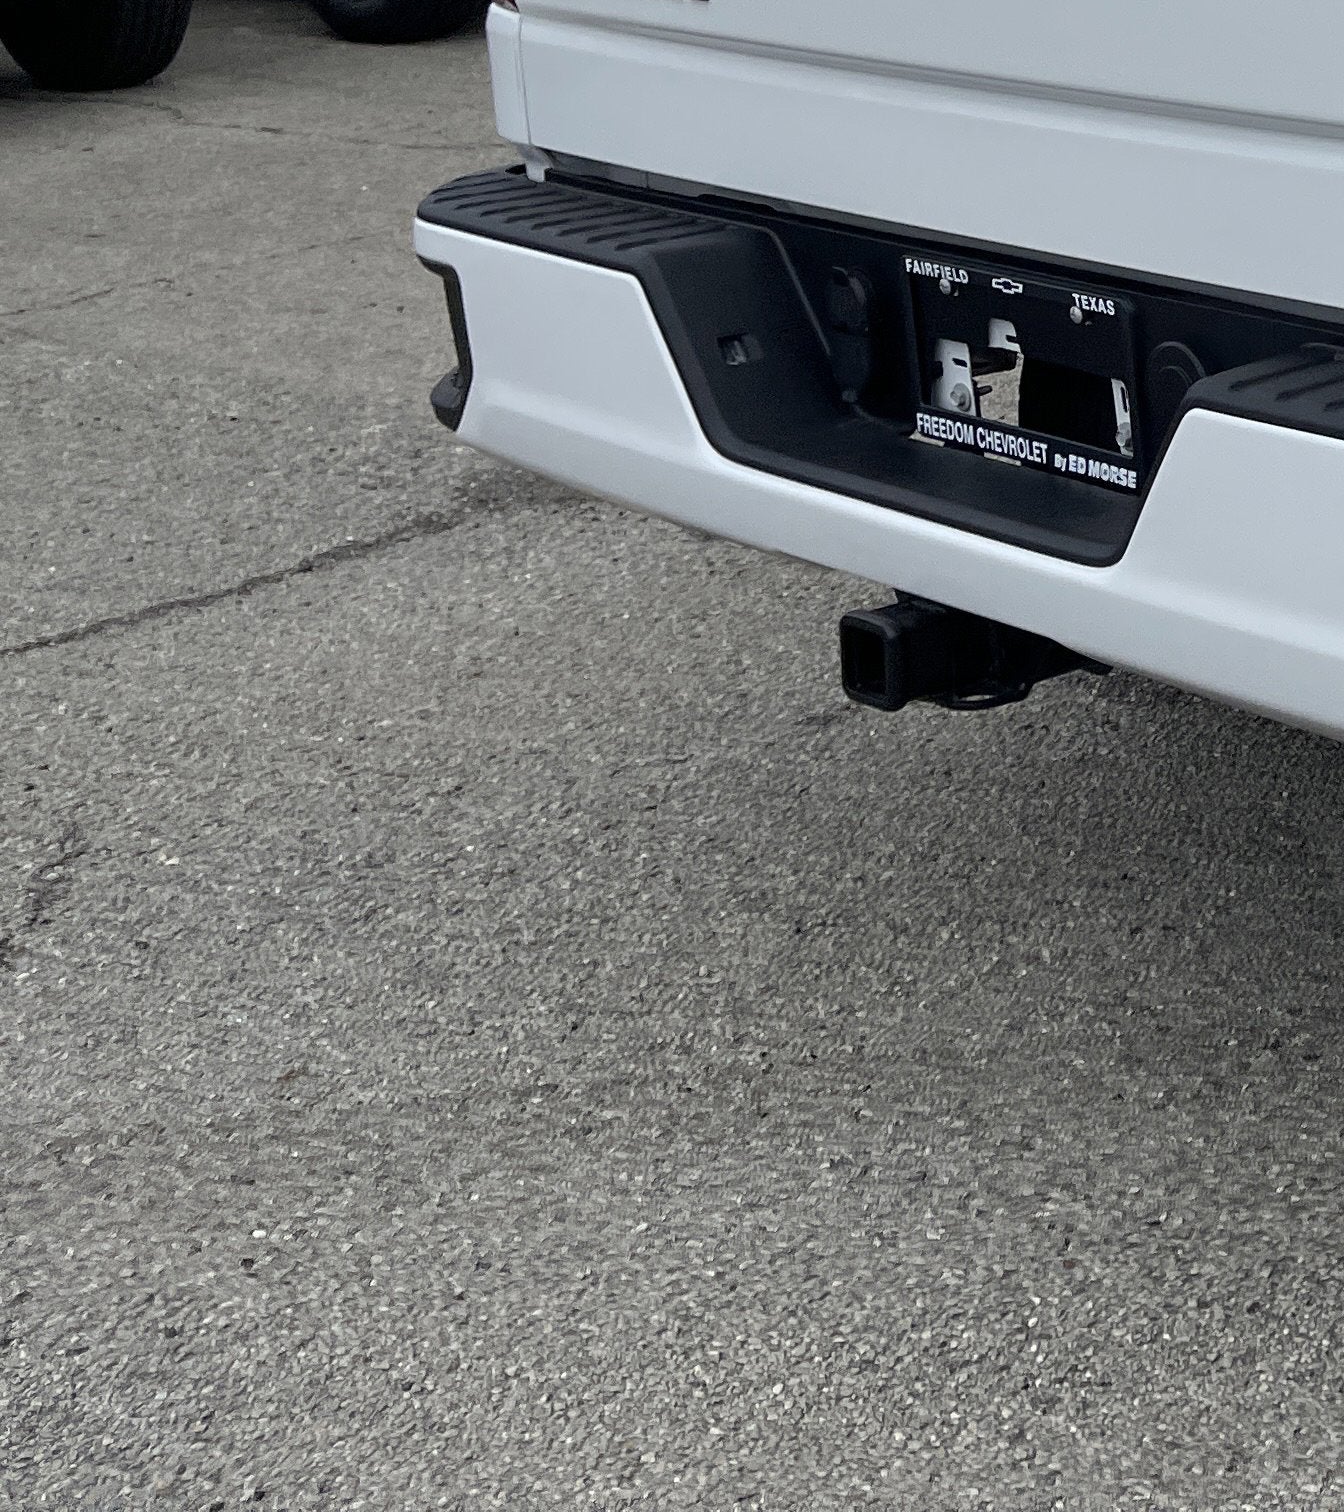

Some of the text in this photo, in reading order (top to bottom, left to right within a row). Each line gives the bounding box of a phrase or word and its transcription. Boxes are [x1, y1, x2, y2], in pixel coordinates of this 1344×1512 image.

[905, 258, 969, 284] FAIRFIELD
[1071, 292, 1116, 316] TEXAS
[916, 412, 974, 446] FREEDOM
[976, 426, 1048, 465] CHEVROLET
[1068, 454, 1086, 475] ED
[1087, 459, 1137, 489] MORSE
